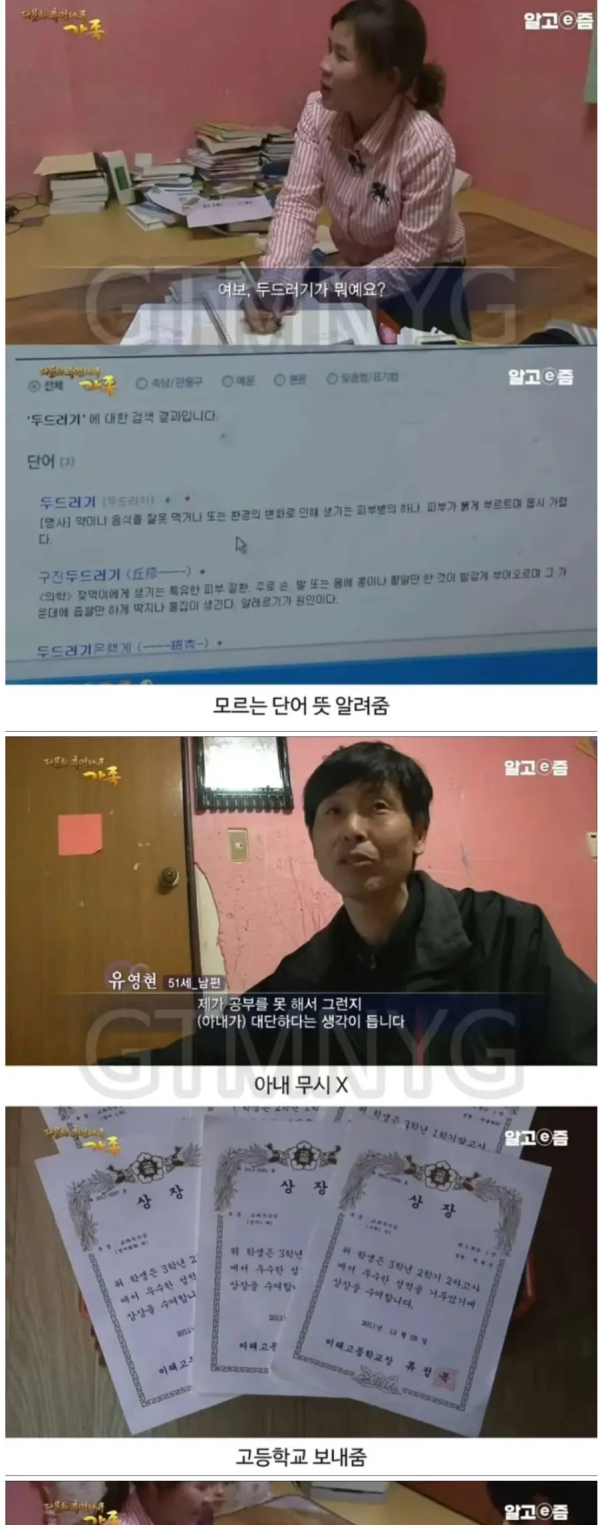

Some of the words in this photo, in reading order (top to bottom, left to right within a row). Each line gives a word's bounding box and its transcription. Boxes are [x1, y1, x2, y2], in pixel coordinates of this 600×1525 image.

[89, 412, 101, 425] 에
[104, 411, 129, 425] 대한
[132, 411, 155, 425] 검색
[159, 409, 216, 424] 결과입니다.
[39, 494, 96, 511] 두드러기
